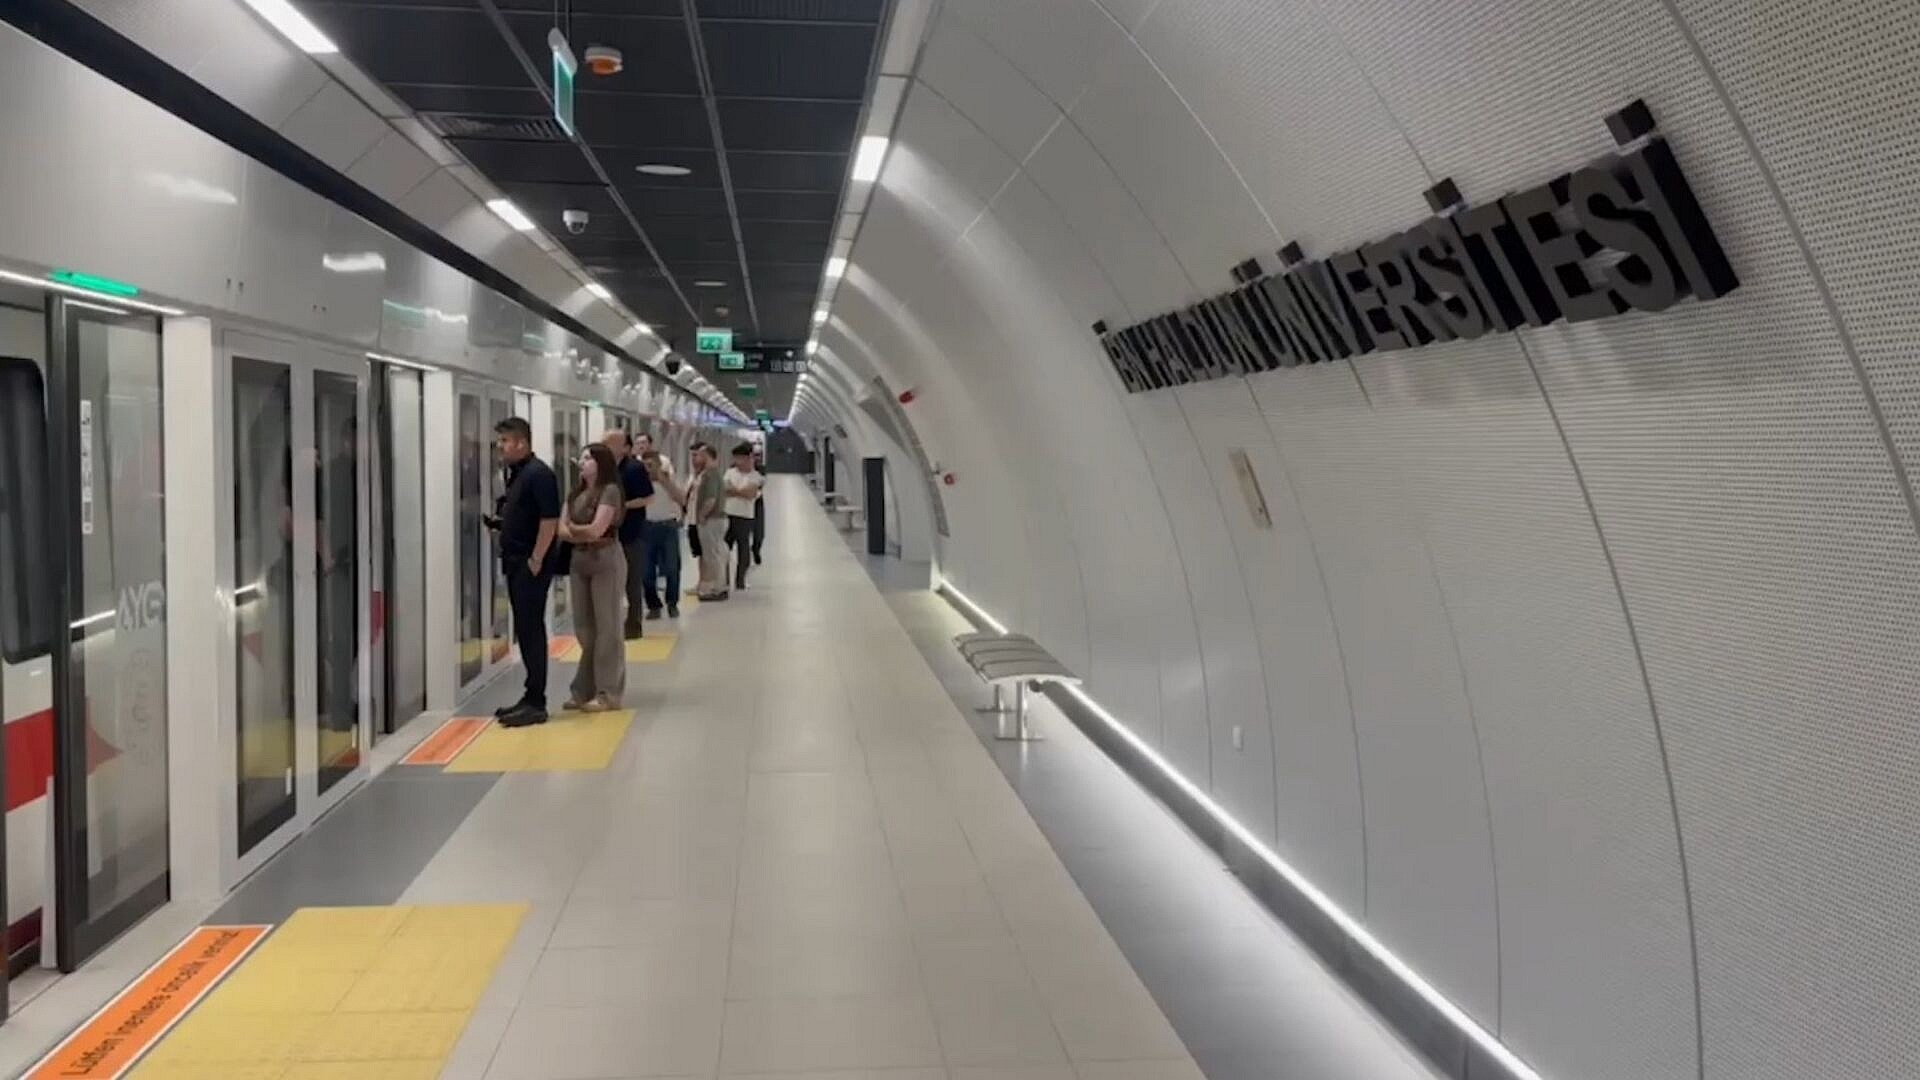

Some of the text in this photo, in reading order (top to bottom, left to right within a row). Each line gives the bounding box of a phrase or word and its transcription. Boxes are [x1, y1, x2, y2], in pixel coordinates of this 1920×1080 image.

[1127, 284, 1273, 389] HALDUN
[1230, 99, 1740, 371] ÜNİVERSİTESİ
[60, 1038, 124, 1075] Lütfen
